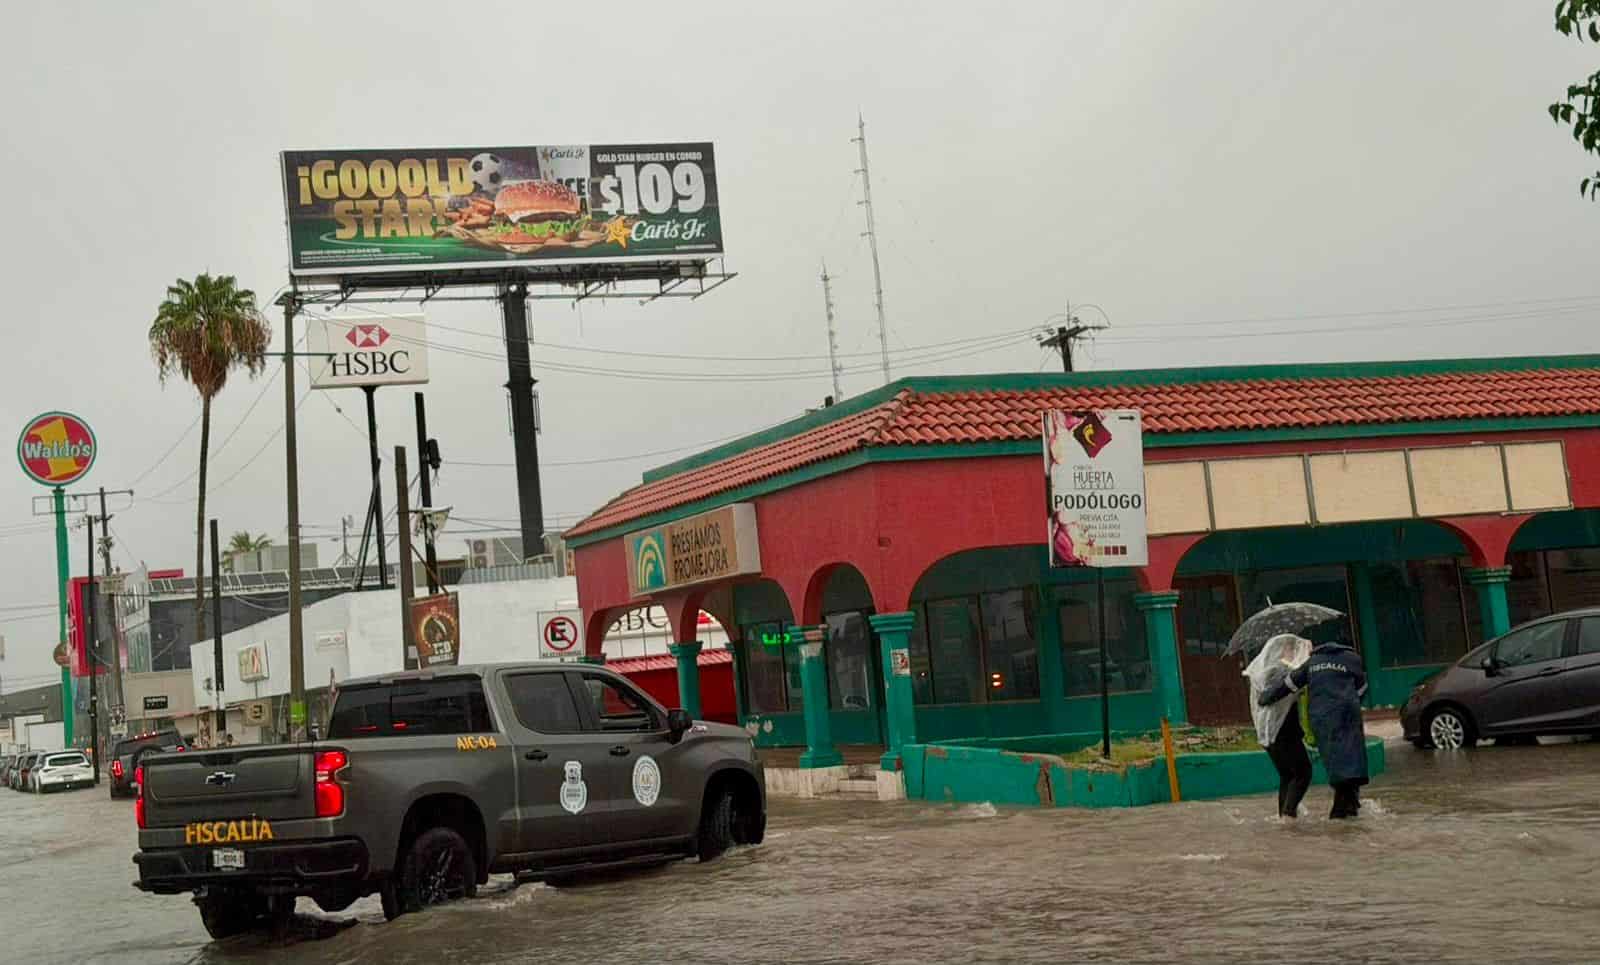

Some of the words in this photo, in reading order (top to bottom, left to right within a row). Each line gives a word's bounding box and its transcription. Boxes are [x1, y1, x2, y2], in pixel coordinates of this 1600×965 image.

[597, 154, 616, 163] GOLD
[617, 153, 635, 162] STAR
[666, 152, 676, 161] EN
[677, 151, 703, 161] COMBO
[600, 162, 706, 216] $109
[632, 219, 681, 242] Carl's
[682, 218, 706, 241] Jr.
[330, 350, 411, 377] HSBC
[24, 438, 92, 459] Waldo's
[1073, 471, 1114, 483] HUERTA
[1054, 491, 1142, 510] PODÓLOGO
[673, 546, 729, 583] PROMEJORA
[456, 735, 497, 750] AIC-04
[184, 818, 273, 844] FISCALÍA
